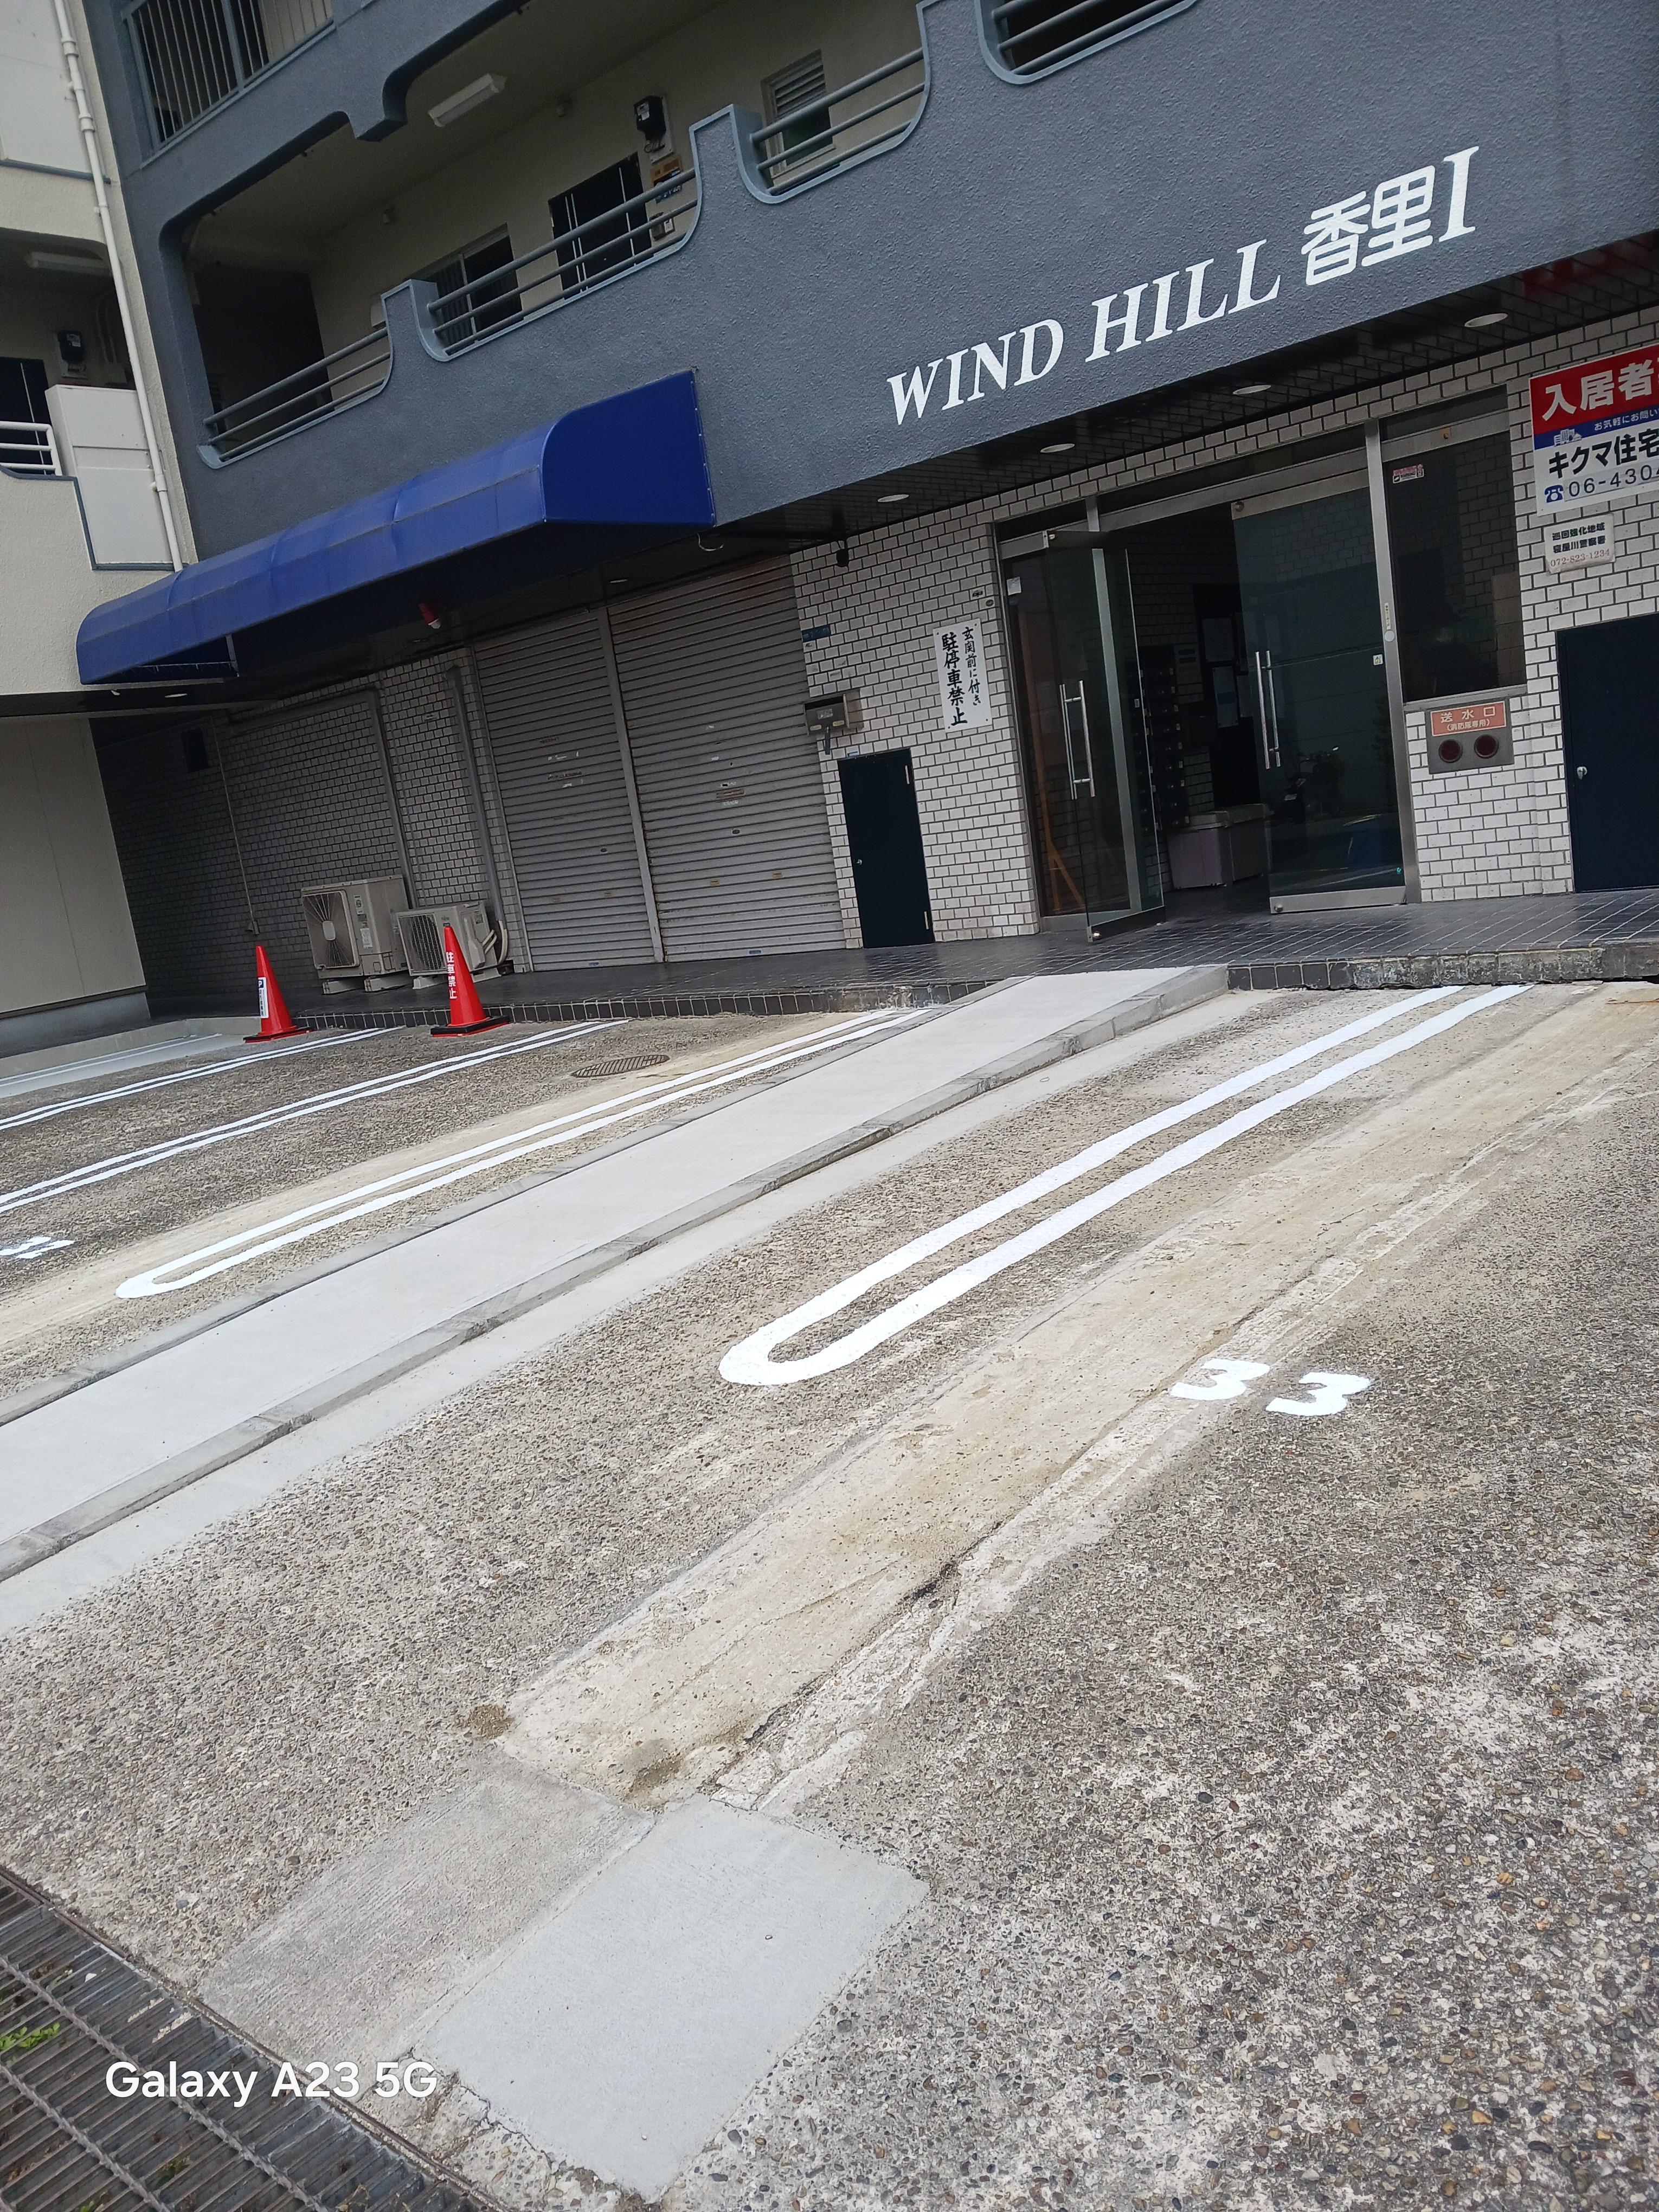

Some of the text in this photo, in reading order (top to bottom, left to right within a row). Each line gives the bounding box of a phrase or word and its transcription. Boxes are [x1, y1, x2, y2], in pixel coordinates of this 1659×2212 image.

[886, 319, 1064, 426] WIND
[1085, 239, 1281, 363] HILL
[1542, 357, 1659, 421] 入居者
[1594, 408, 1659, 431] お気軽にお問い
[1549, 428, 1659, 479] キクマ住宅
[1568, 465, 1659, 497] 06-430
[1551, 549, 1610, 567] 072-823-1234
[941, 632, 968, 726] 駐停車禁止
[962, 627, 981, 706] 玄関前に付き
[1441, 706, 1495, 723] 送水口
[1169, 1358, 1374, 1416] 33
